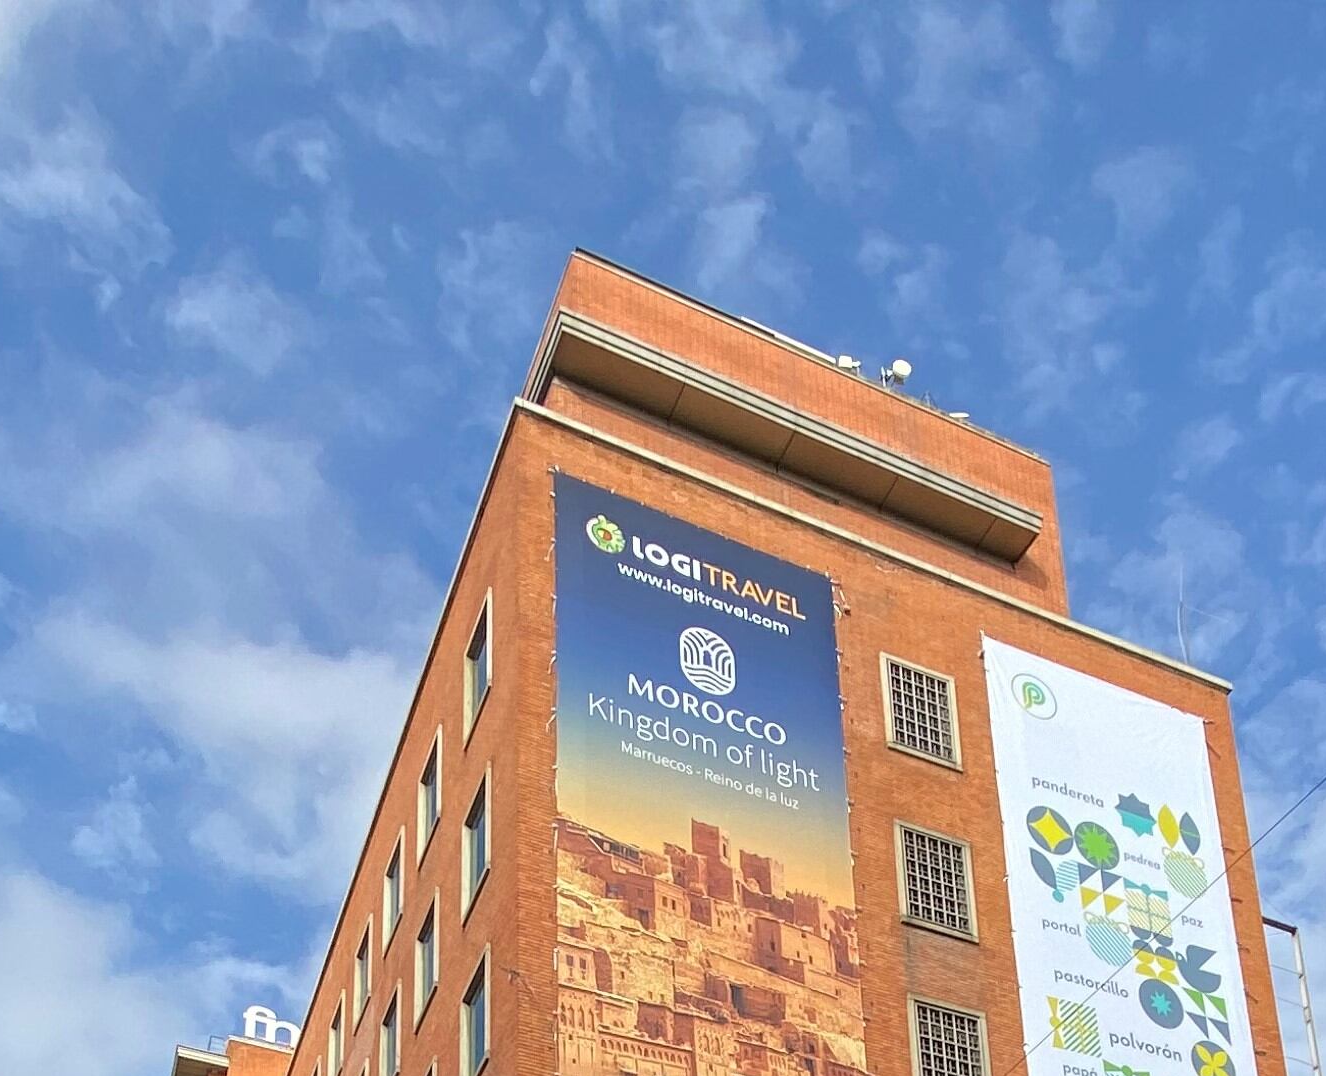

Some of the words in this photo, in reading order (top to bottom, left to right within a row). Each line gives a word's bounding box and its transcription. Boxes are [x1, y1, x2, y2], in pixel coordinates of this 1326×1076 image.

[632, 535, 807, 621] LOGITRAVEL
[617, 561, 790, 636] www.logitravel.com
[628, 673, 787, 745] MOROCCO
[588, 693, 718, 757] Kingdom
[726, 742, 753, 768] of
[760, 750, 821, 791] light
[621, 740, 693, 775] Marruecos
[704, 767, 742, 791] Reino
[745, 781, 764, 798] de
[765, 786, 777, 802] la
[780, 790, 800, 810] luz
[1032, 775, 1104, 809] pandereta
[1123, 851, 1161, 871] pedrea
[1042, 916, 1082, 938] portal
[1181, 914, 1204, 928] paz
[1053, 968, 1130, 998] pastorcillo
[1109, 1031, 1183, 1062] polvorón
